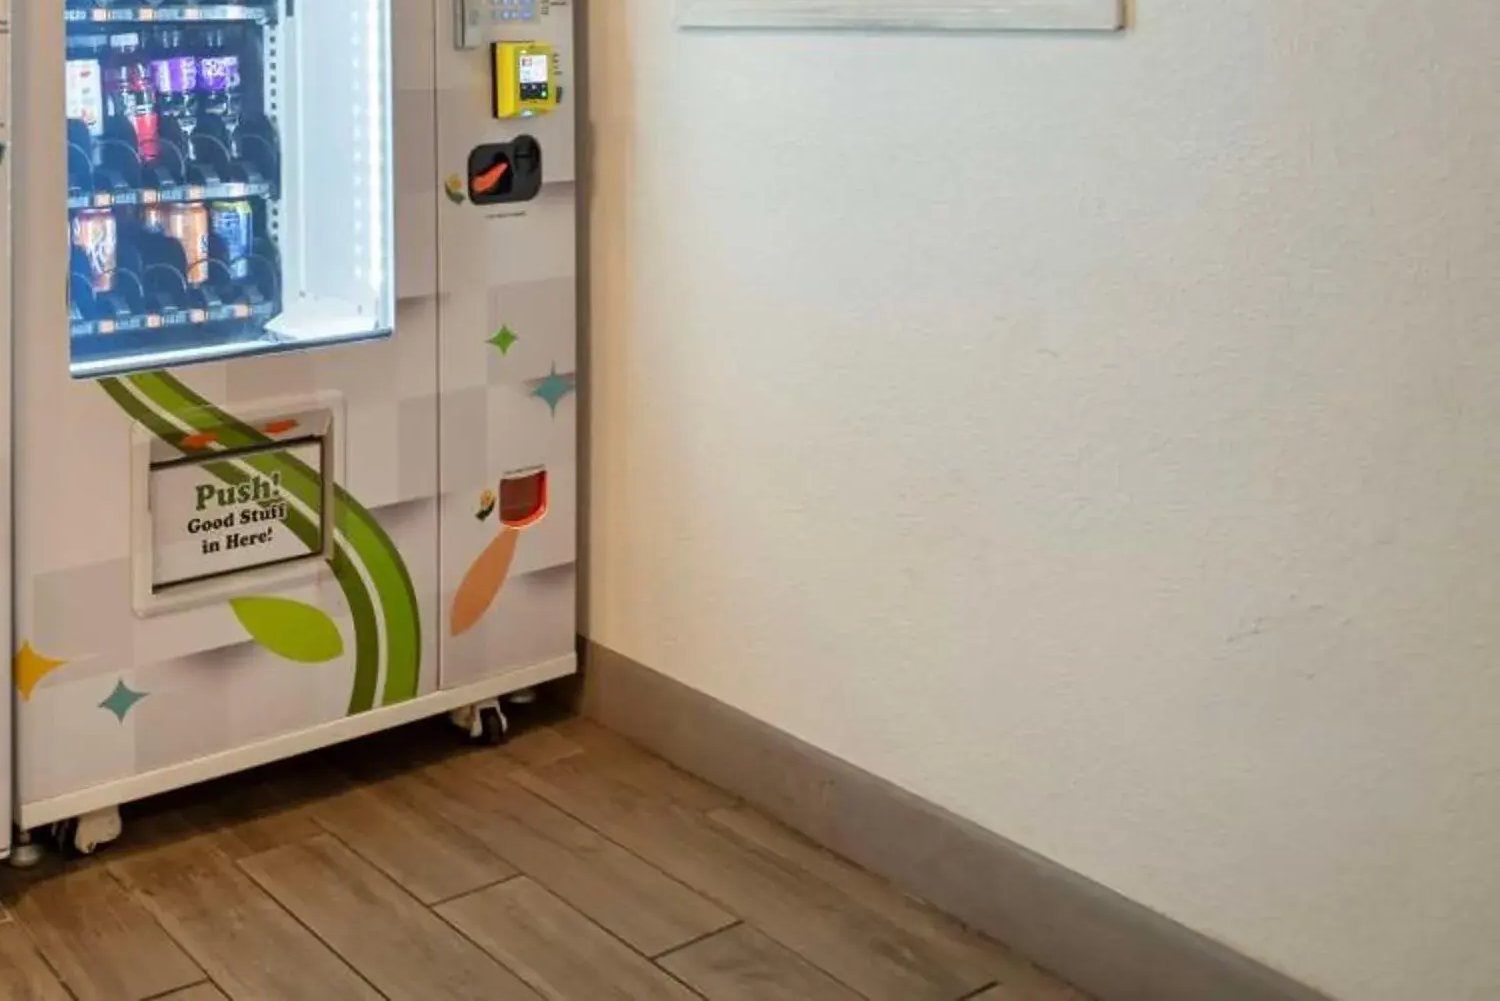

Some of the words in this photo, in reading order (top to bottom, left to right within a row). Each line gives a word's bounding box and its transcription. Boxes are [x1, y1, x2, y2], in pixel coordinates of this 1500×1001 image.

[195, 472, 282, 511] Push!
[187, 513, 235, 534] Good
[239, 502, 287, 524] Stuff
[202, 539, 220, 554] in
[226, 527, 273, 550] Here!
